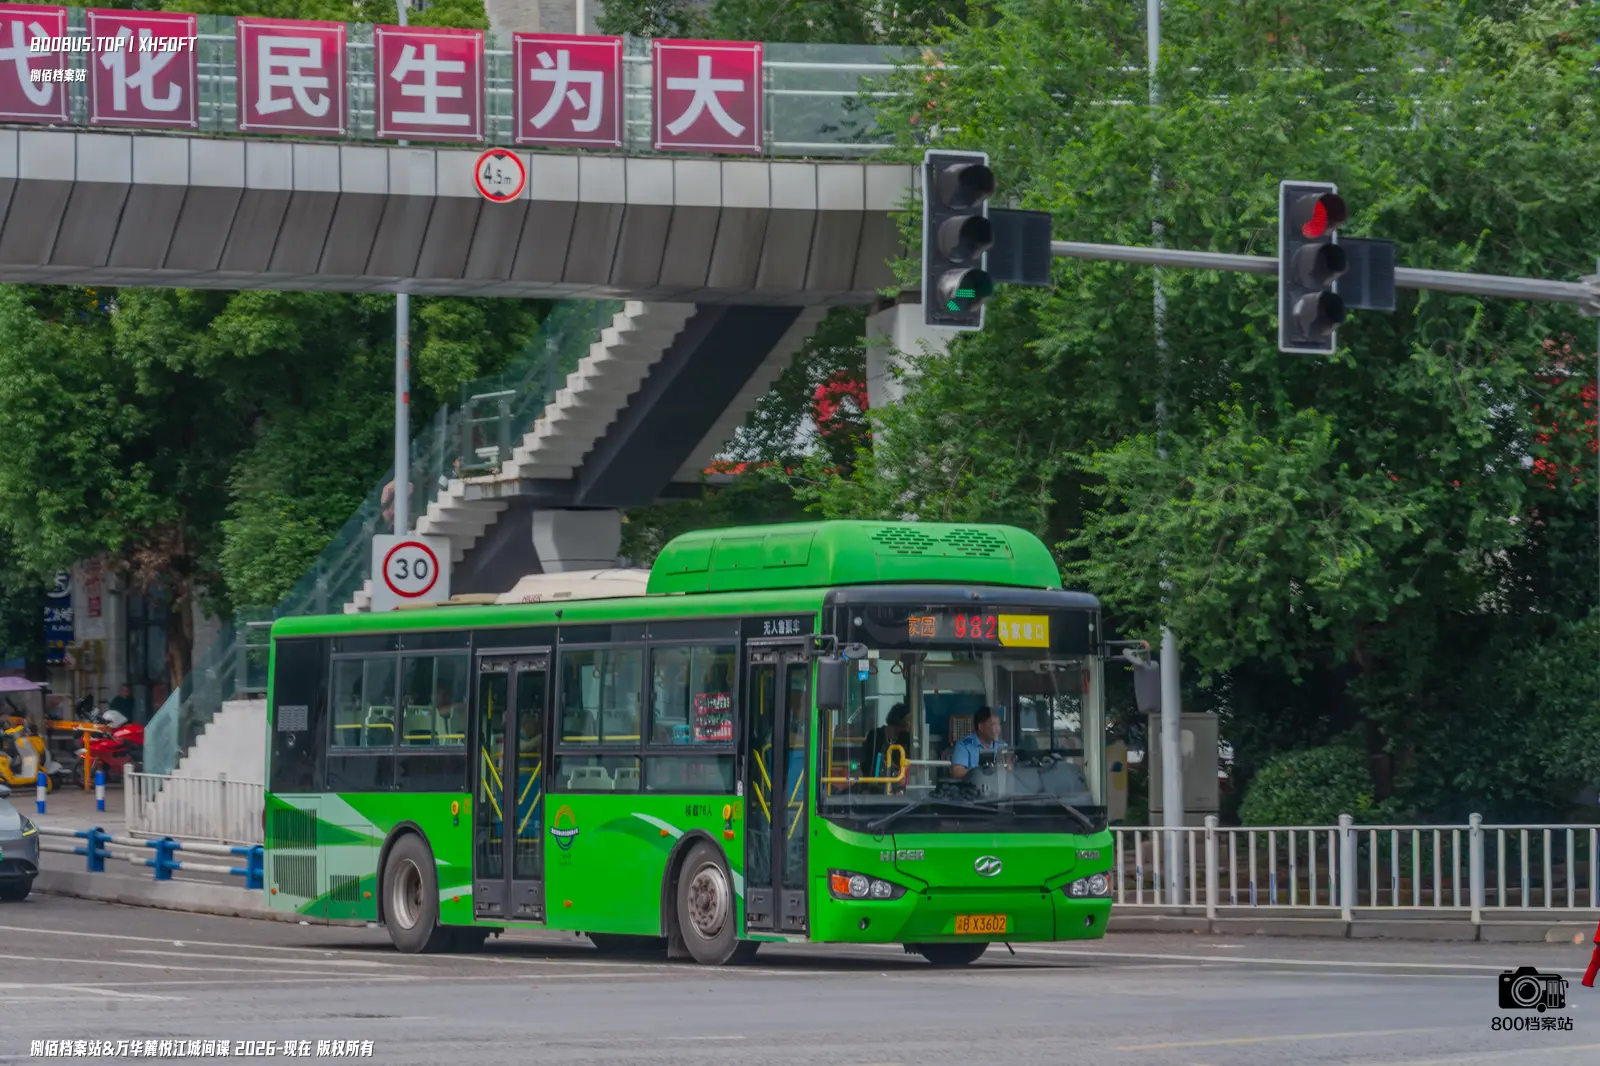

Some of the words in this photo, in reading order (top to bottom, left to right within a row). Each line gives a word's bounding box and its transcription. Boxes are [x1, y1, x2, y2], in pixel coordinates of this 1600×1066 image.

[483, 162, 512, 185] 4.5m
[394, 558, 429, 580] 30
[955, 615, 997, 639] 982
[880, 849, 925, 862] HIGER
